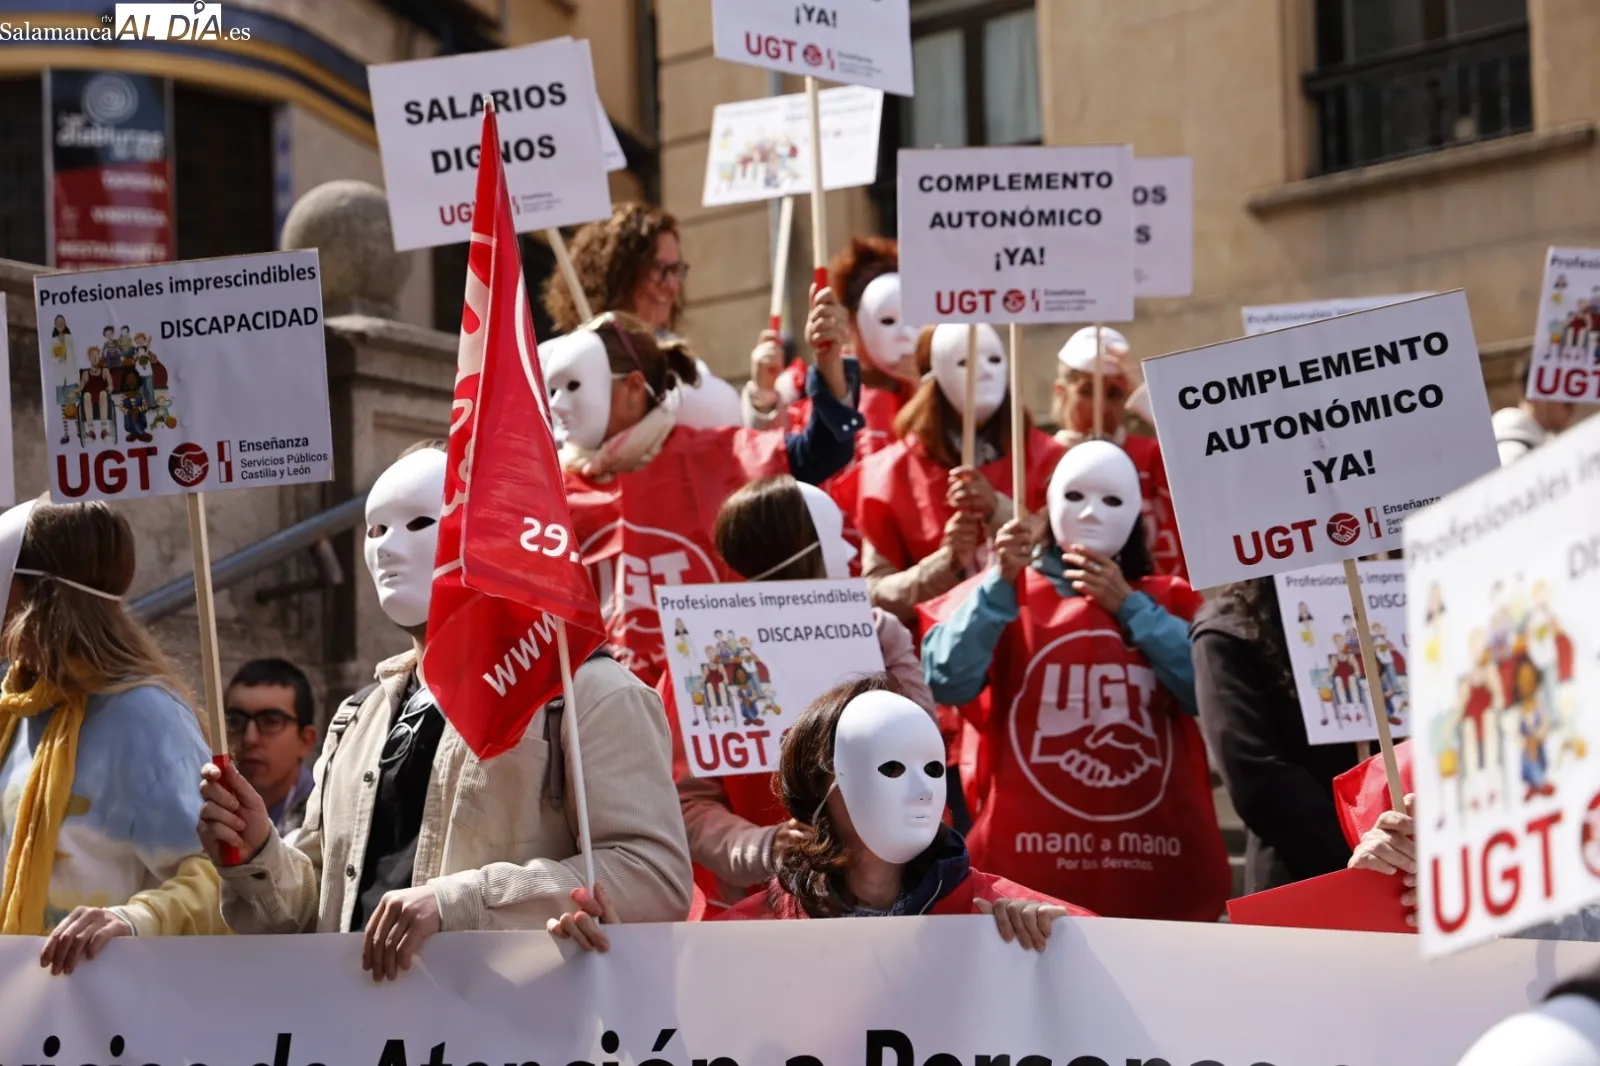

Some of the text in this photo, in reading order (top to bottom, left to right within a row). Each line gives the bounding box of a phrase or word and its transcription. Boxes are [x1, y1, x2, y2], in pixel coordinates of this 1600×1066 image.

[795, 5, 837, 28] ¡YA!
[744, 31, 797, 62] UGT
[404, 82, 567, 126] SALARIOS
[918, 170, 1113, 192] COMPLEMENTO
[439, 202, 476, 226] UG
[929, 205, 1102, 229] AUTONÓMICO
[994, 247, 1045, 272] ¡YA!
[39, 263, 316, 306] Profesionales imprescindibles
[935, 289, 997, 315] UGT
[160, 307, 318, 339] DISCAPACIDAD
[1178, 331, 1449, 410] COMPLEMENTO
[1205, 384, 1444, 456] AUTONÓMICO
[239, 437, 309, 452] Enseñanza
[57, 446, 157, 498] UGT
[241, 453, 328, 469] Servicios Públicos
[241, 465, 311, 480] Castilla y León
[1304, 449, 1376, 494] ¡YA!
[1232, 519, 1317, 566] UGT
[661, 589, 867, 611] Profesionales imprescindibles
[757, 622, 873, 643] DISCAPACIDAD
[1036, 663, 1157, 736] UGT
[691, 730, 770, 771] UGT
[1100, 838, 1112, 852] a
[1118, 832, 1181, 857] mano
[1056, 857, 1079, 870] Por
[1431, 810, 1563, 934] UGT
